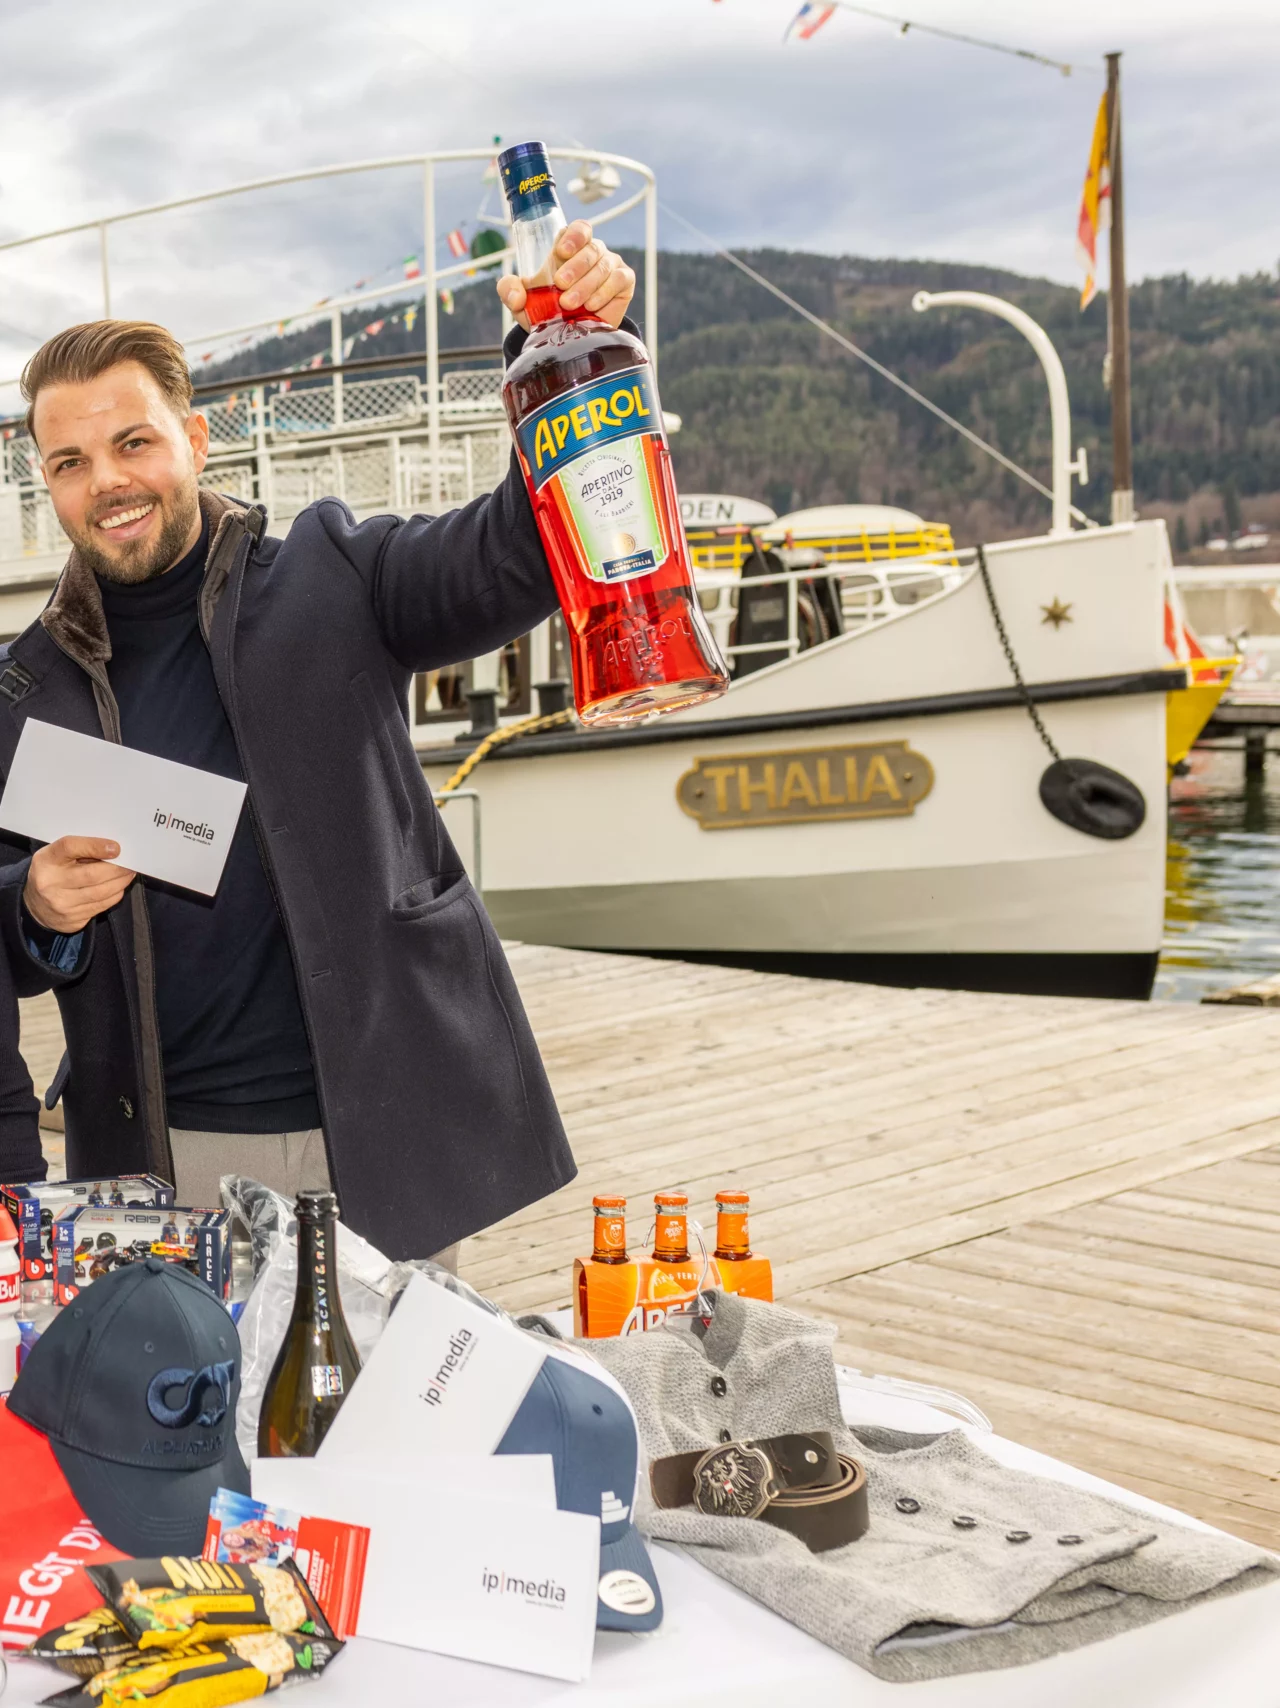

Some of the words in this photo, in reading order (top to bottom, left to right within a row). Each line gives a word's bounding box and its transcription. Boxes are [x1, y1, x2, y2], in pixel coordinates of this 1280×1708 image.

[519, 172, 549, 195] APEROL
[534, 385, 651, 470] APEROL
[581, 464, 633, 498] APERITIVO
[602, 484, 618, 494] DAL
[600, 488, 624, 507] 1919
[703, 754, 902, 813] THALIA
